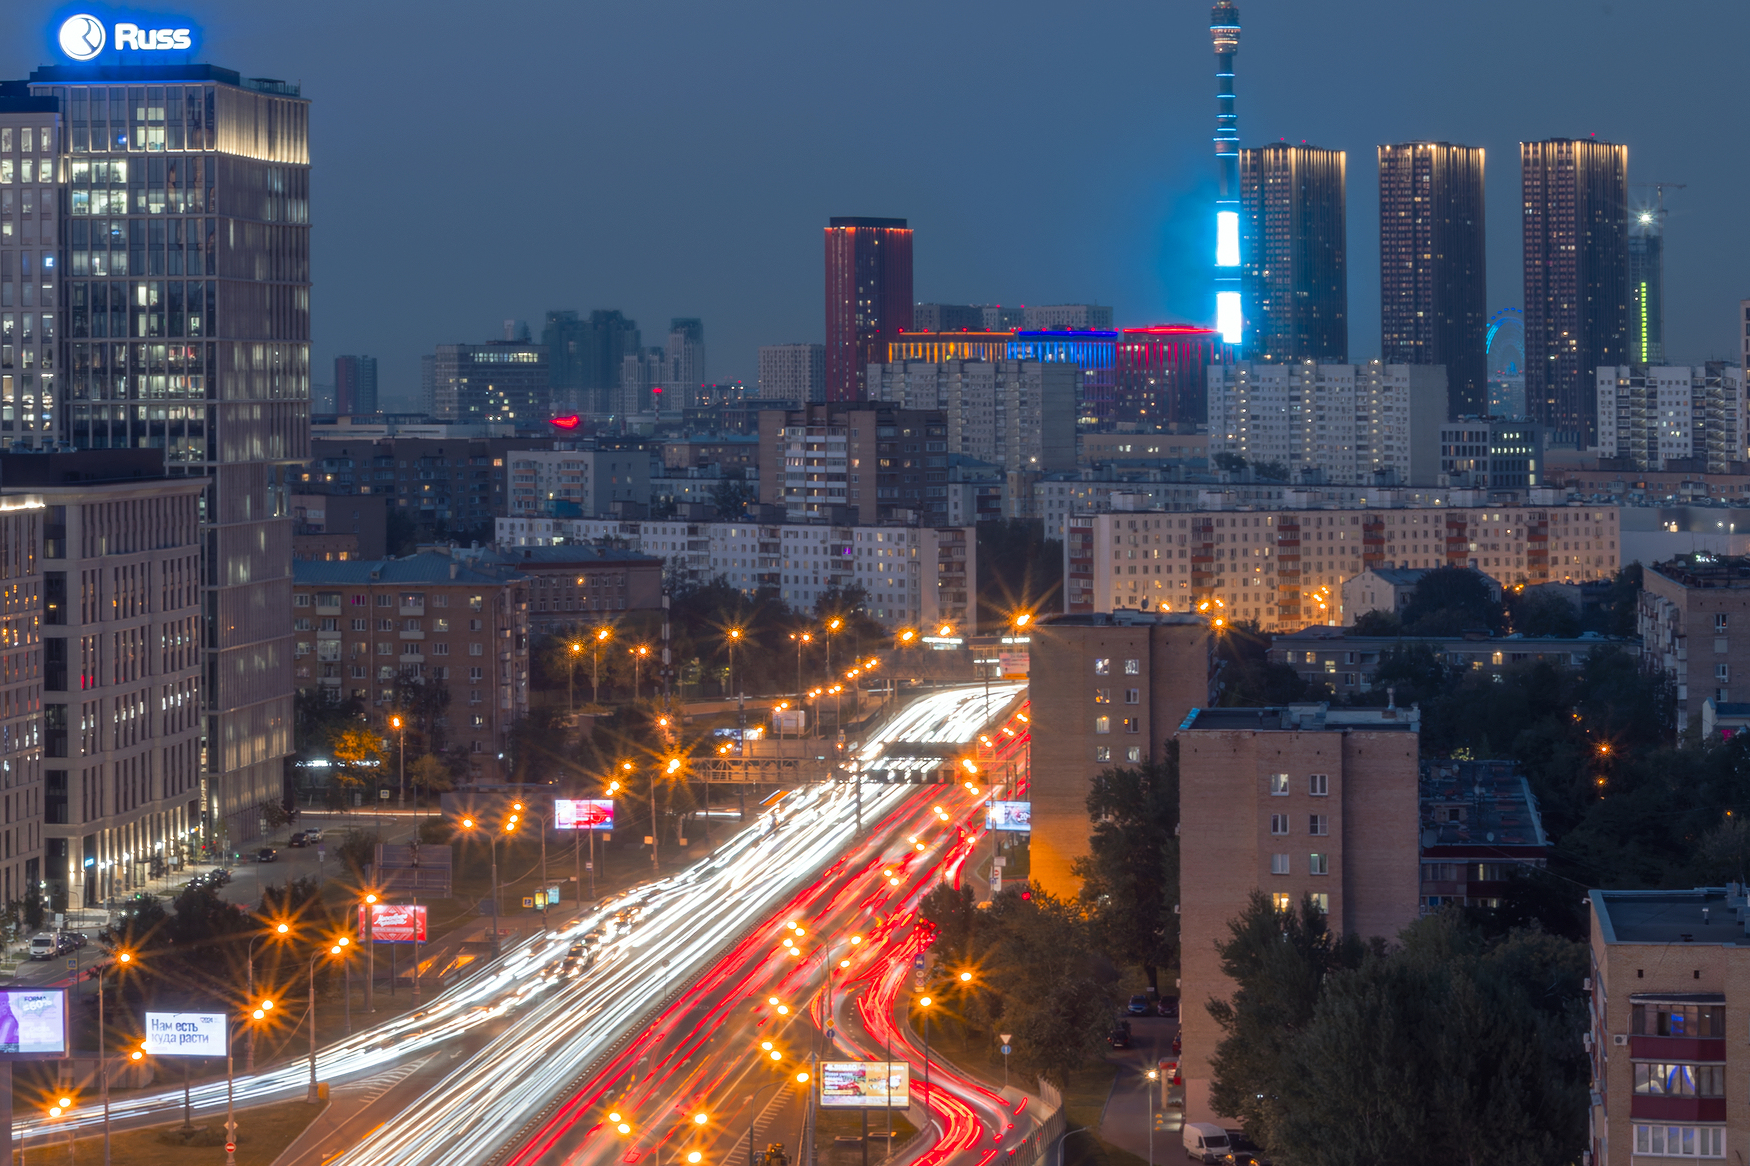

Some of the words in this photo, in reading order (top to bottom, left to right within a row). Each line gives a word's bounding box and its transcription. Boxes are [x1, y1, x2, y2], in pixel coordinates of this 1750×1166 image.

[114, 23, 192, 51] Russ
[151, 1018, 173, 1031] Нам
[175, 1022, 199, 1032] есть
[151, 1033, 177, 1045] куда
[179, 1033, 209, 1045] расти
